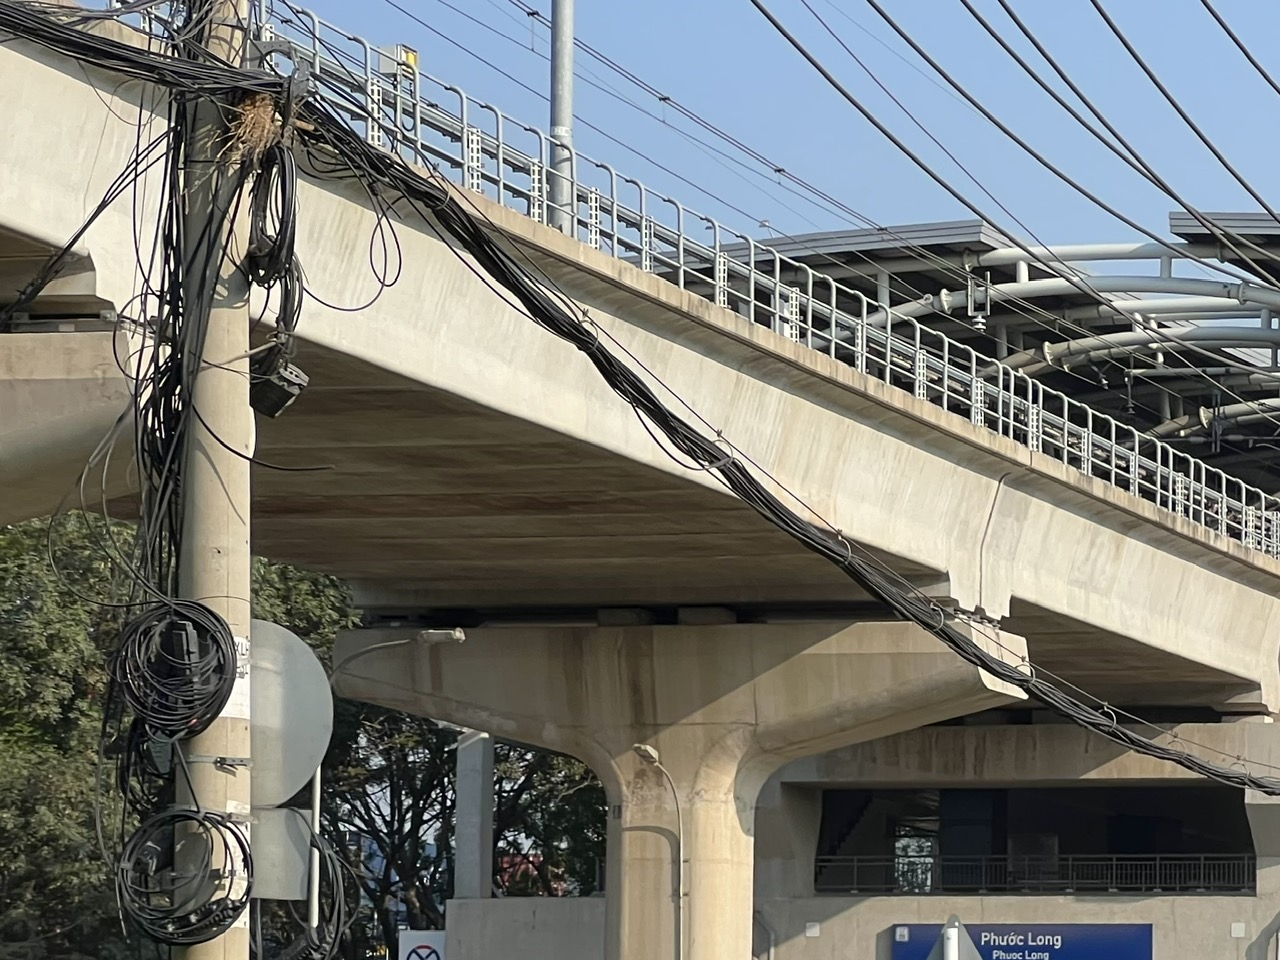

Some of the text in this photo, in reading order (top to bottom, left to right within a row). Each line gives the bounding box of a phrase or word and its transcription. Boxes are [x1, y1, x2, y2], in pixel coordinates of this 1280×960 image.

[981, 932, 1062, 949] Phước Long
[992, 950, 1023, 960] Phuoc
